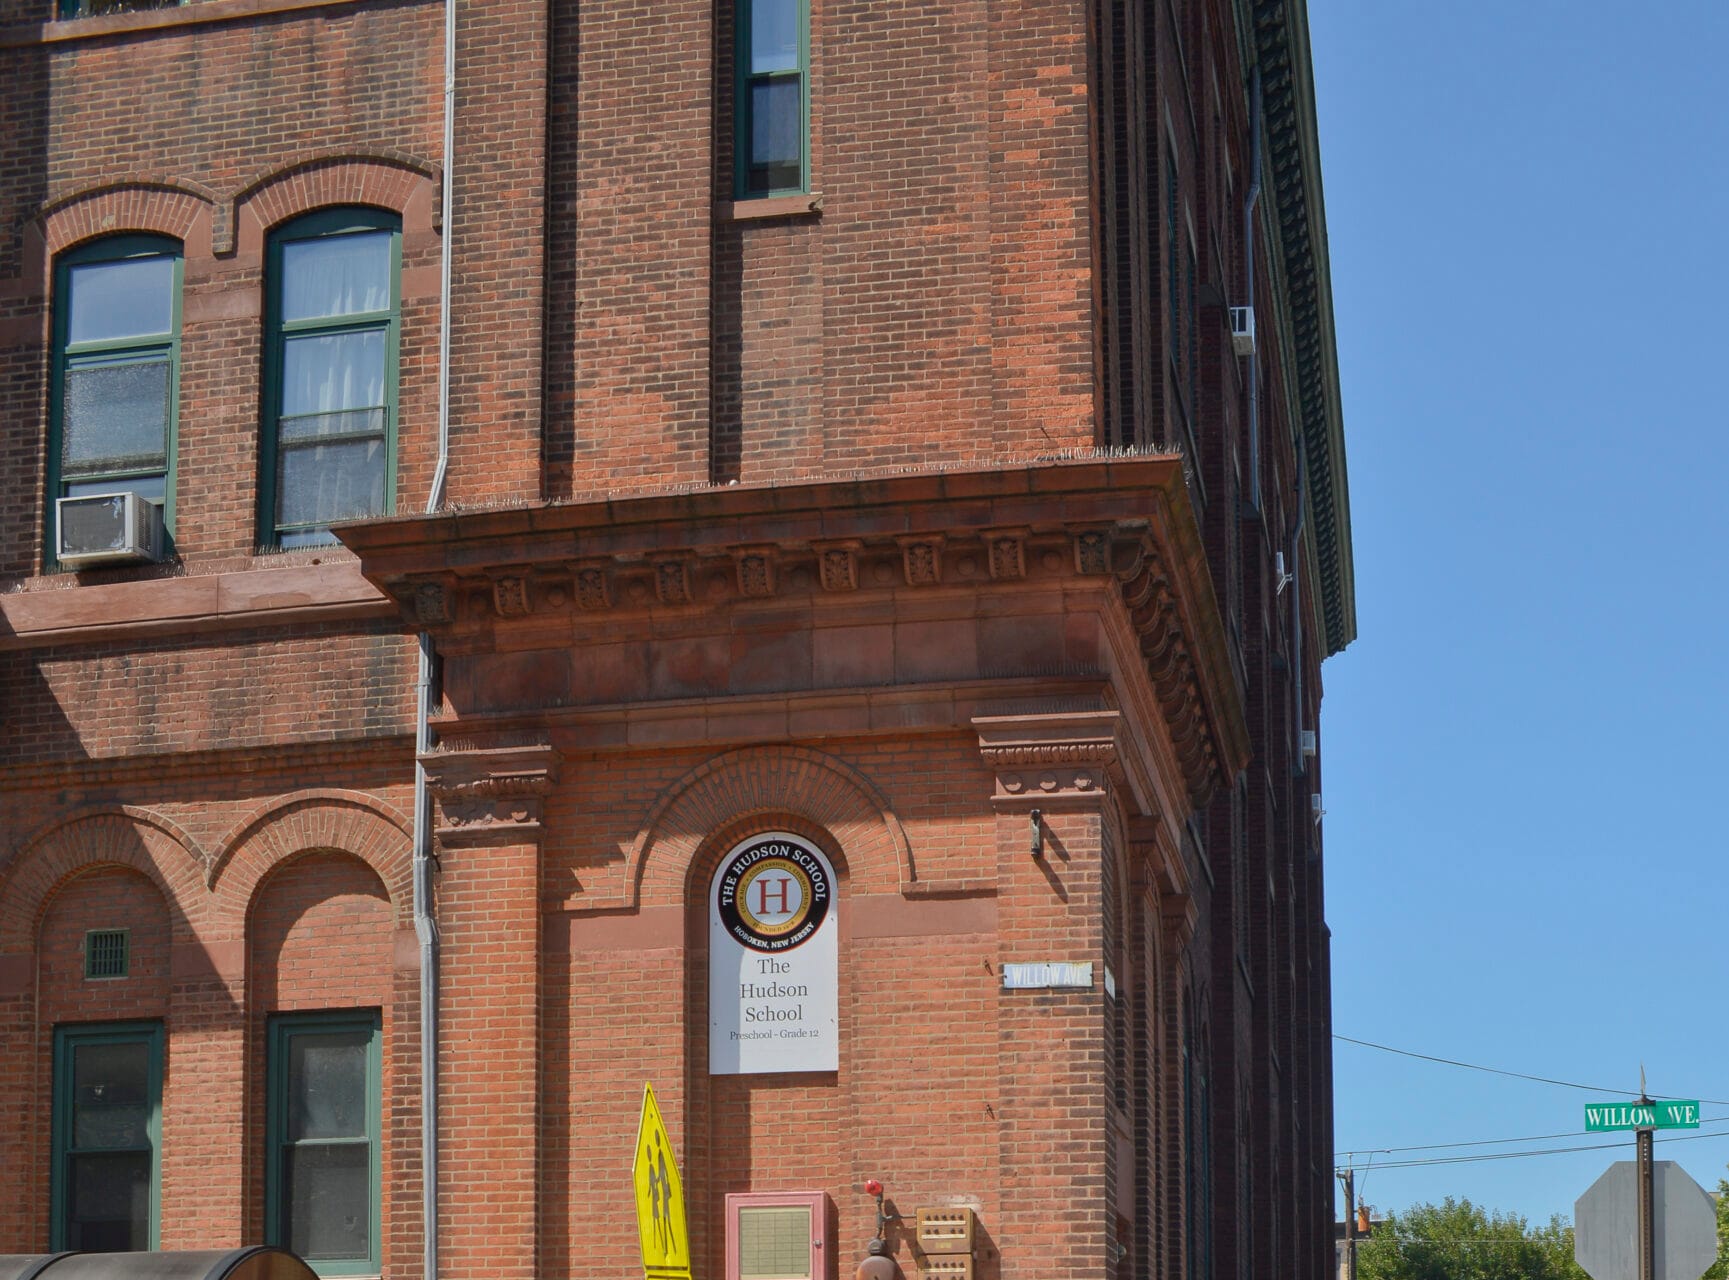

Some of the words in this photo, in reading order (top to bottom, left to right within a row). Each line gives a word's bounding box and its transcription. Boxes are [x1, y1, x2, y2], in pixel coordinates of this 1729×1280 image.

[722, 875, 737, 906] THE
[732, 845, 791, 875] HUDSON
[792, 849, 826, 902] SCHOOL
[756, 878, 792, 915] H
[771, 939, 789, 949] NEW
[791, 922, 815, 944] JERSEY
[757, 958, 791, 974] The
[1012, 966, 1060, 985] WILLOW
[740, 982, 808, 999] Hudson
[745, 1005, 803, 1023] School
[730, 1030, 772, 1041] Preschool
[780, 1029, 807, 1039] Grade
[809, 1029, 819, 1038] 12
[1586, 1107, 1656, 1126] WILLOW
